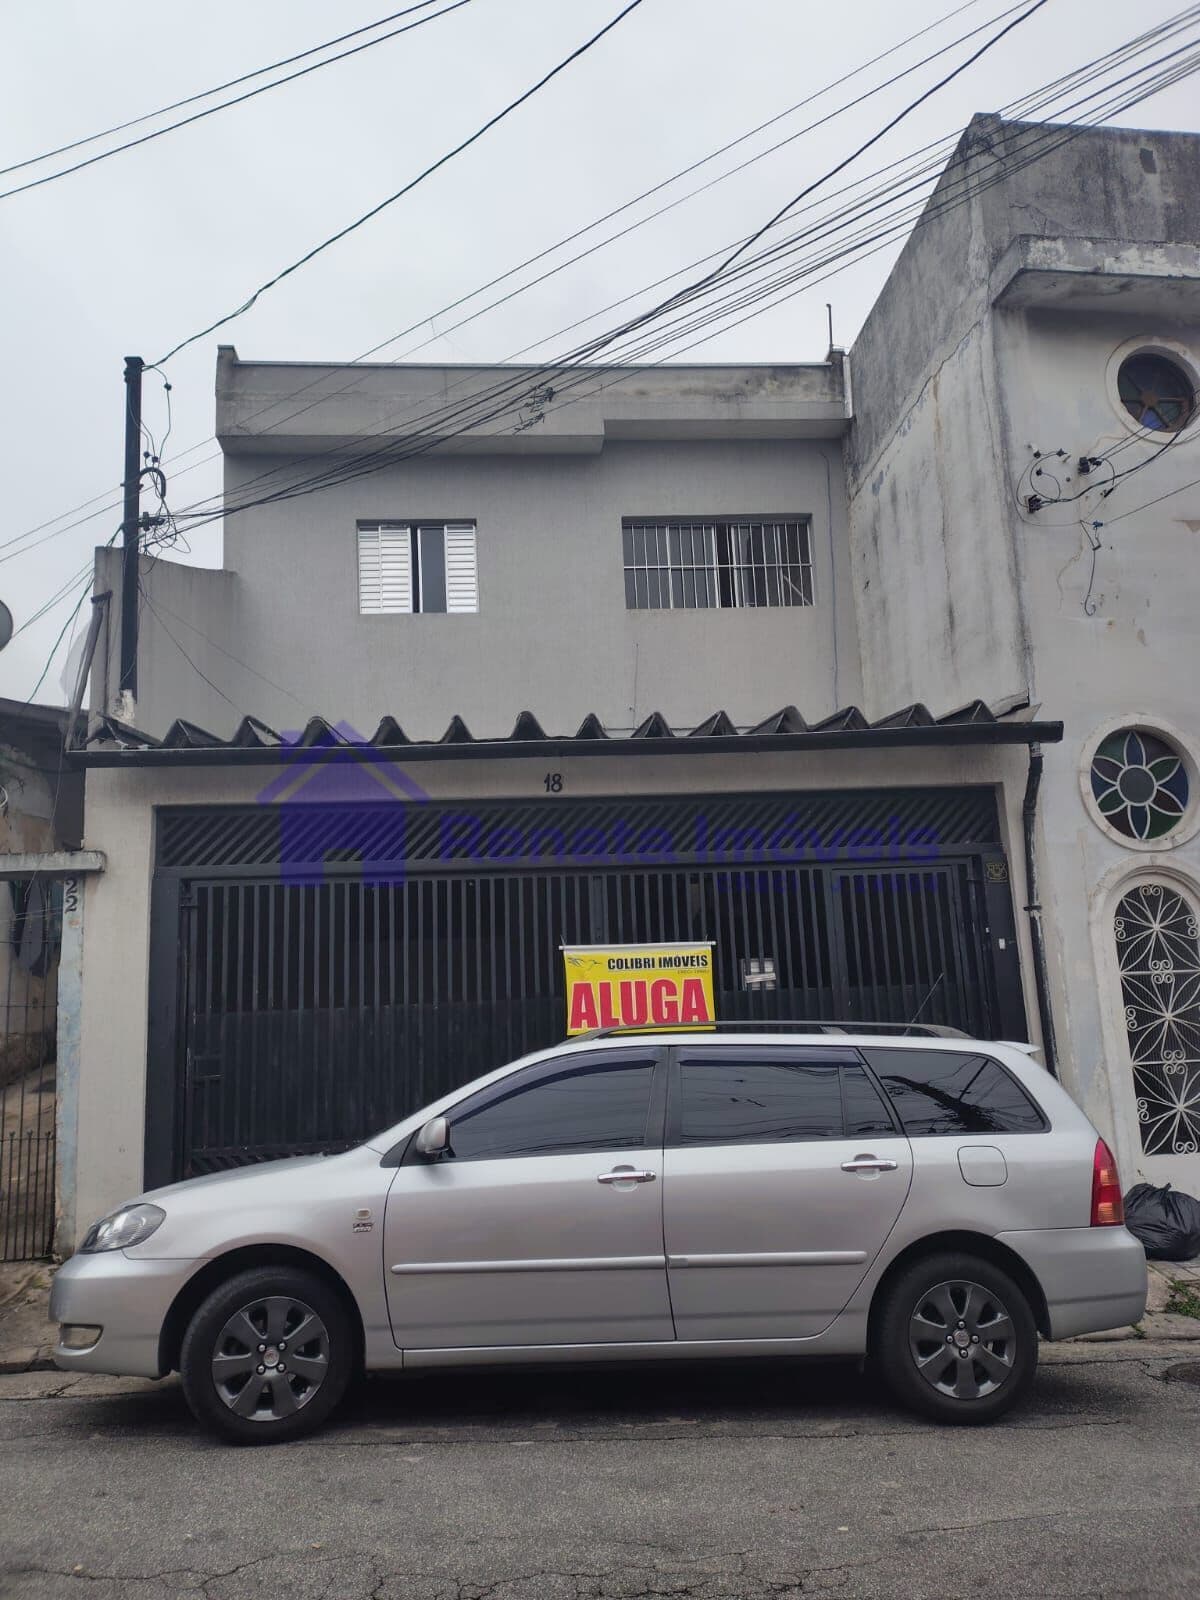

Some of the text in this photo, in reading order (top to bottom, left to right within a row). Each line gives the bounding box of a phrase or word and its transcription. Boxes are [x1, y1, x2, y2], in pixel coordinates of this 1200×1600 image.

[544, 773, 563, 792] 18
[608, 957, 655, 970] COLIBRI
[570, 978, 709, 1029] ALUGA
